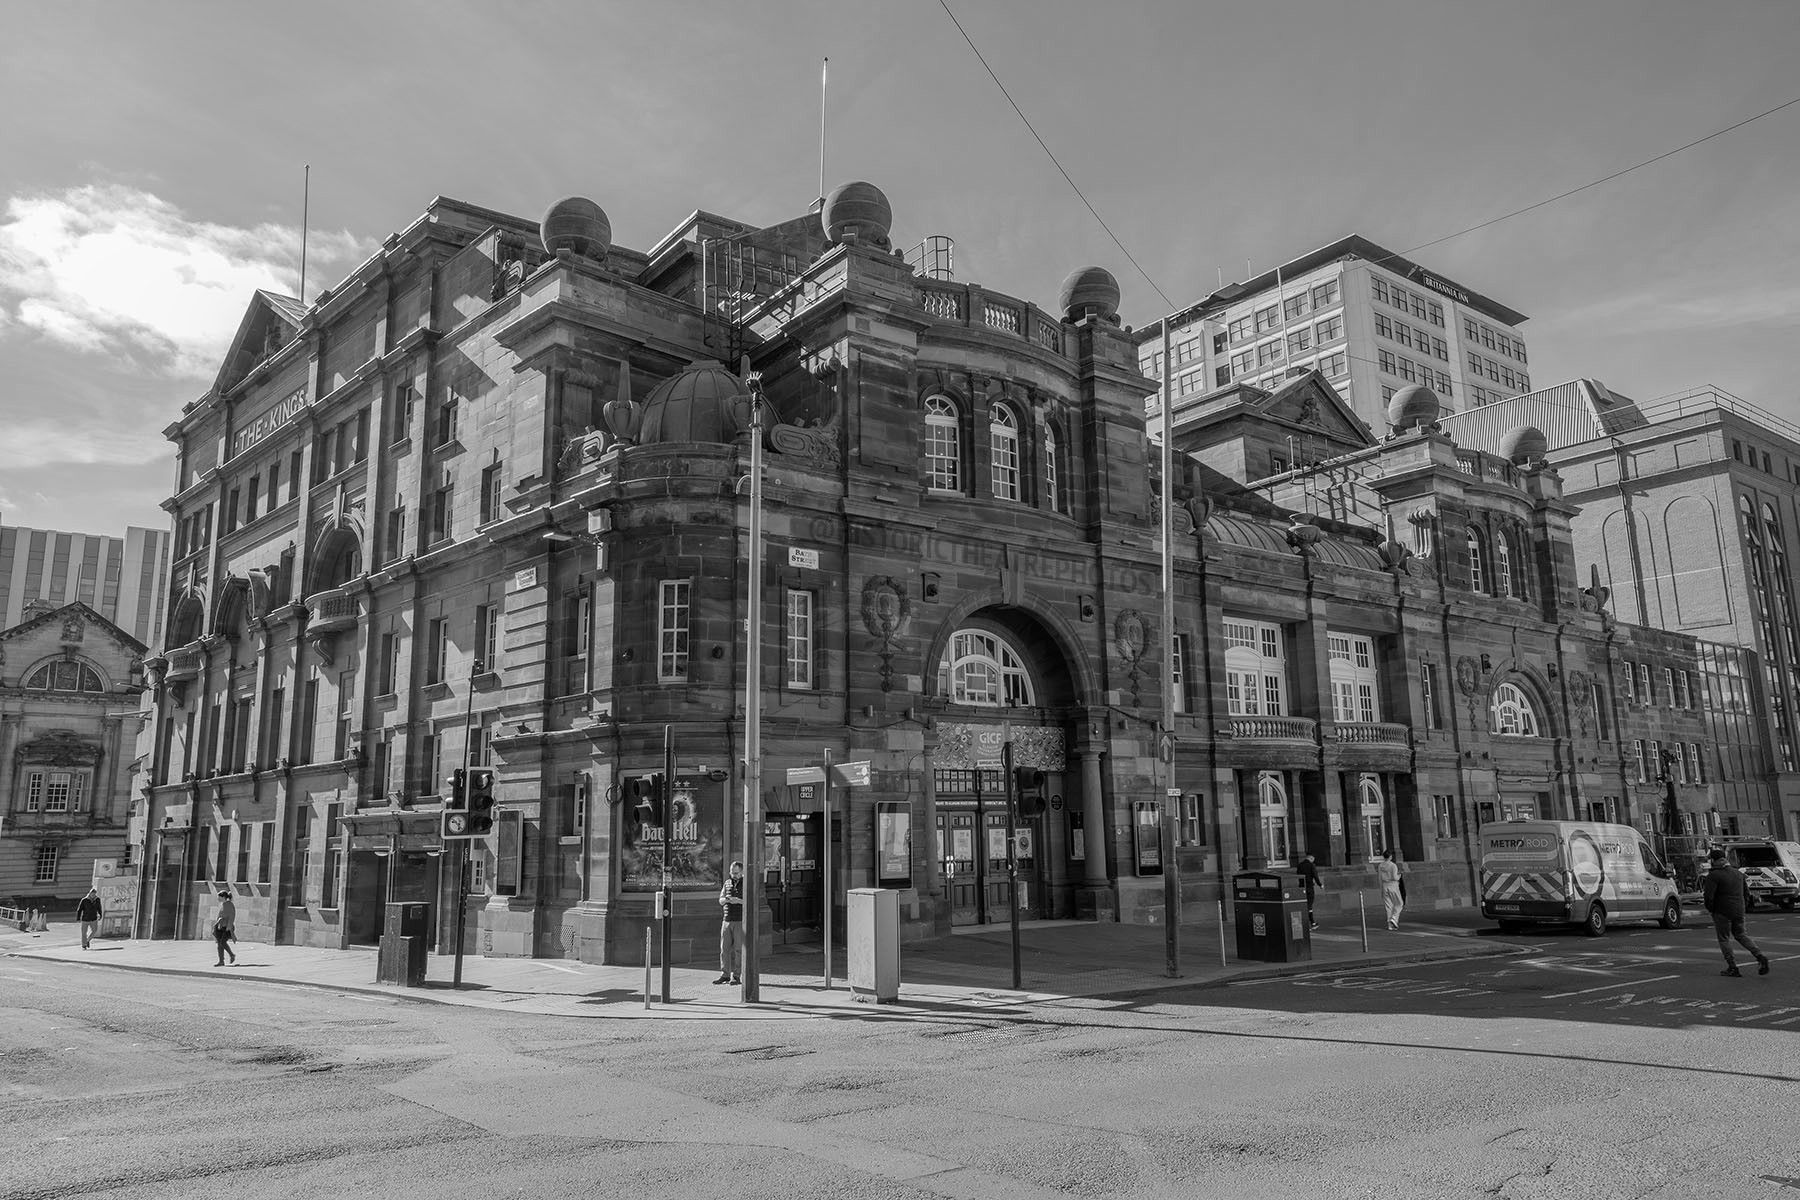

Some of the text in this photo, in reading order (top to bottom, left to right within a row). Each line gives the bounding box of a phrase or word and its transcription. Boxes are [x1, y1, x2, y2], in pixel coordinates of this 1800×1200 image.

[1425, 277, 1469, 304] BRITANNIA INN
[239, 389, 305, 451] THE KING'S
[979, 732, 1002, 744] GICF
[673, 820, 697, 841] Hell
[1490, 838, 1549, 848] METRO ROD
